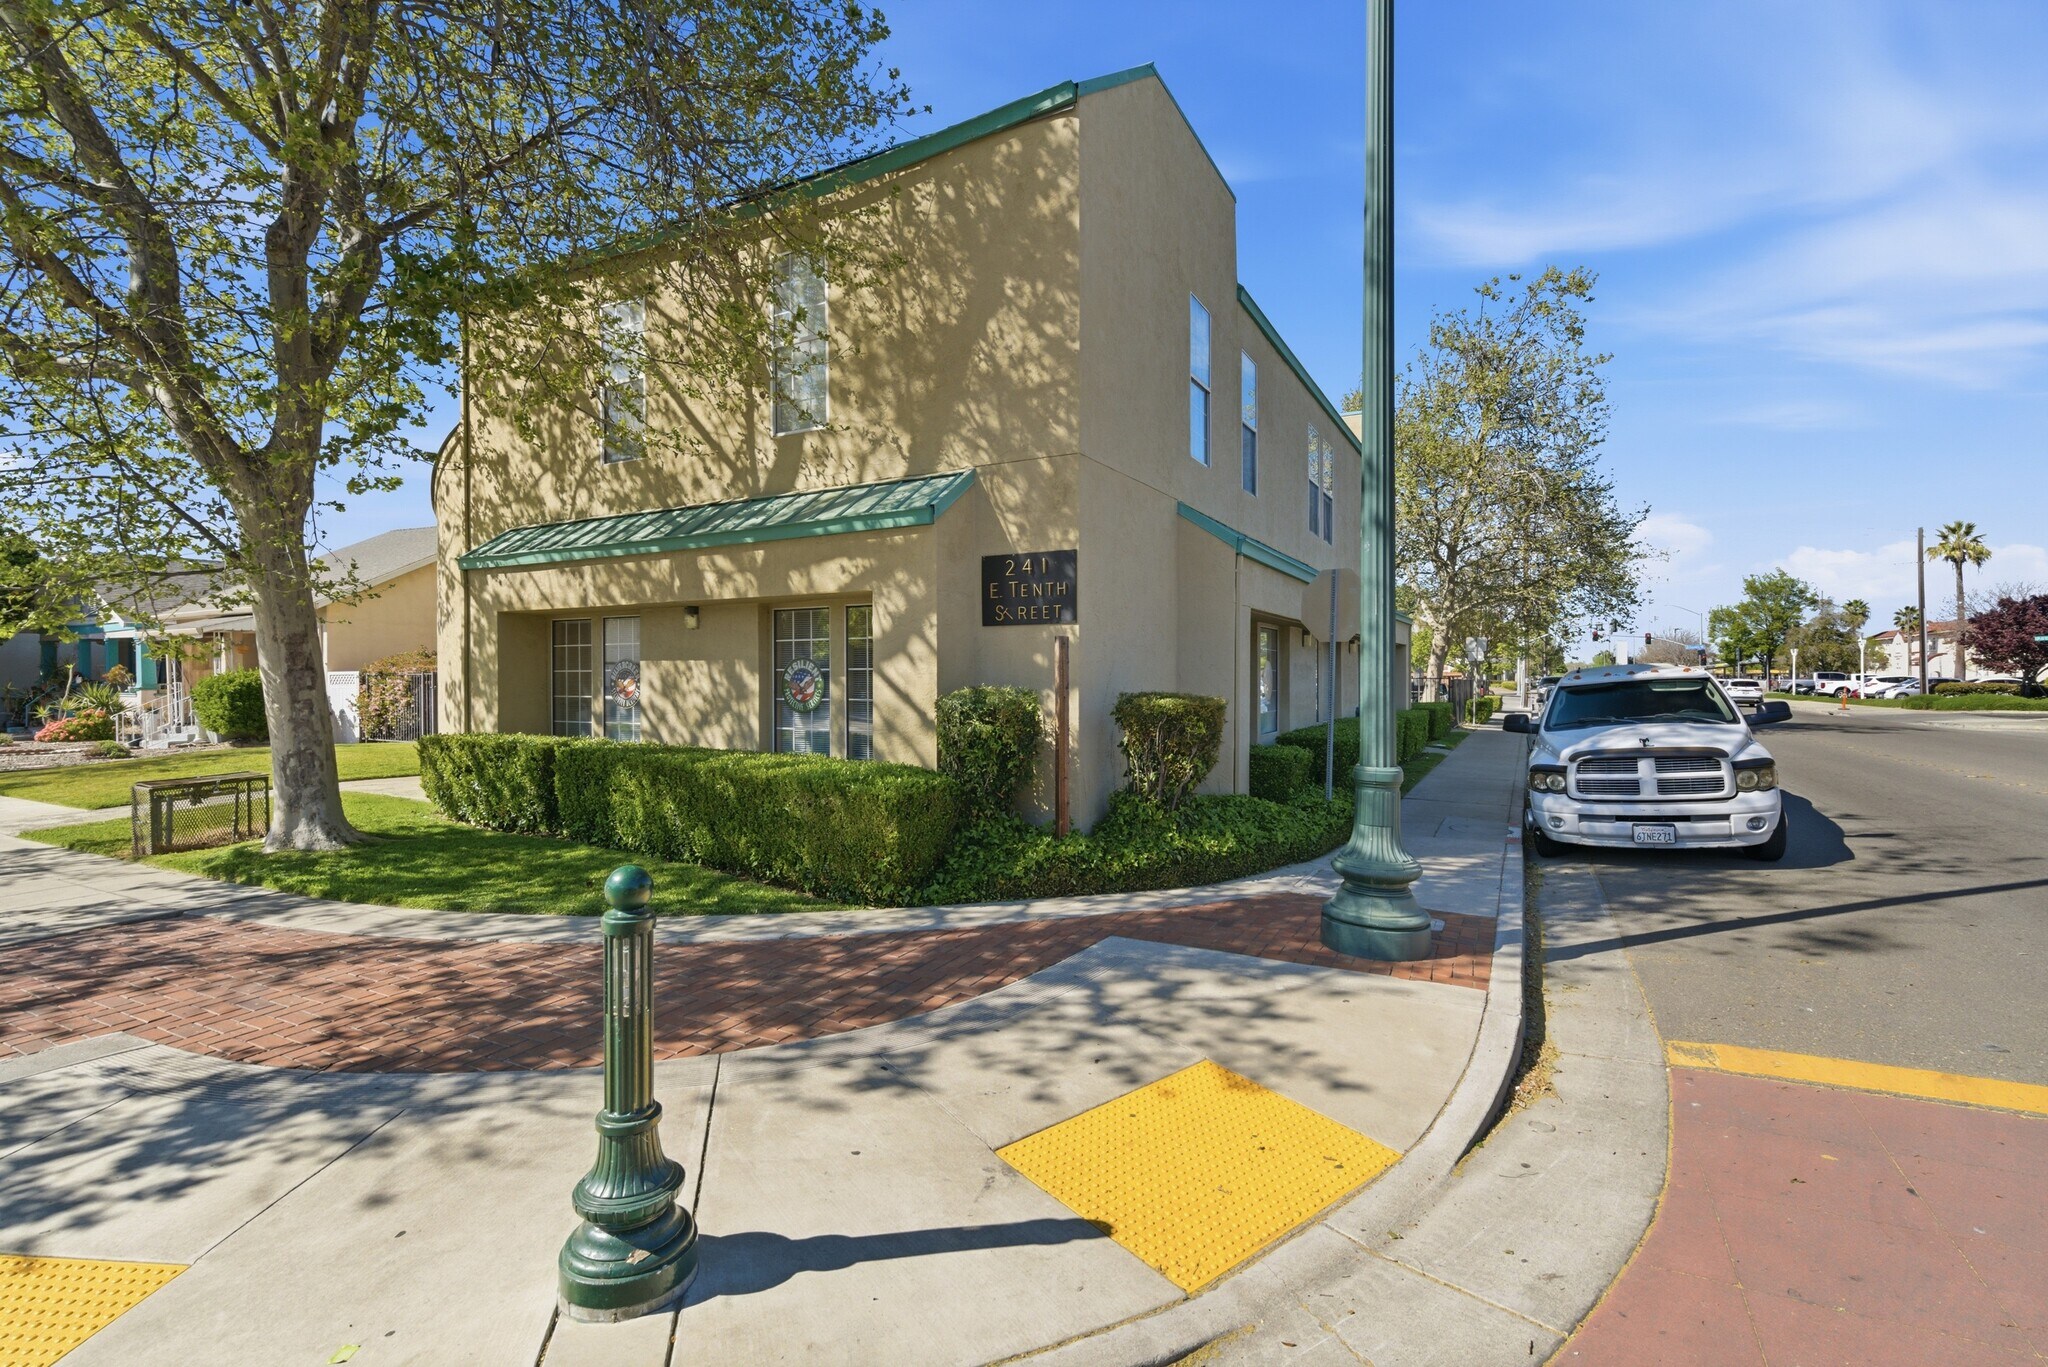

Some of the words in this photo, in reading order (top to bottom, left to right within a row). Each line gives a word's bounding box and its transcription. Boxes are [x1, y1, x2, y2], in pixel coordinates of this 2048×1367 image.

[1005, 557, 1045, 576] 241
[1008, 581, 1066, 598] TENTH
[784, 660, 822, 682] RESILIENT
[1636, 832, 1672, 842] 6JNE271
